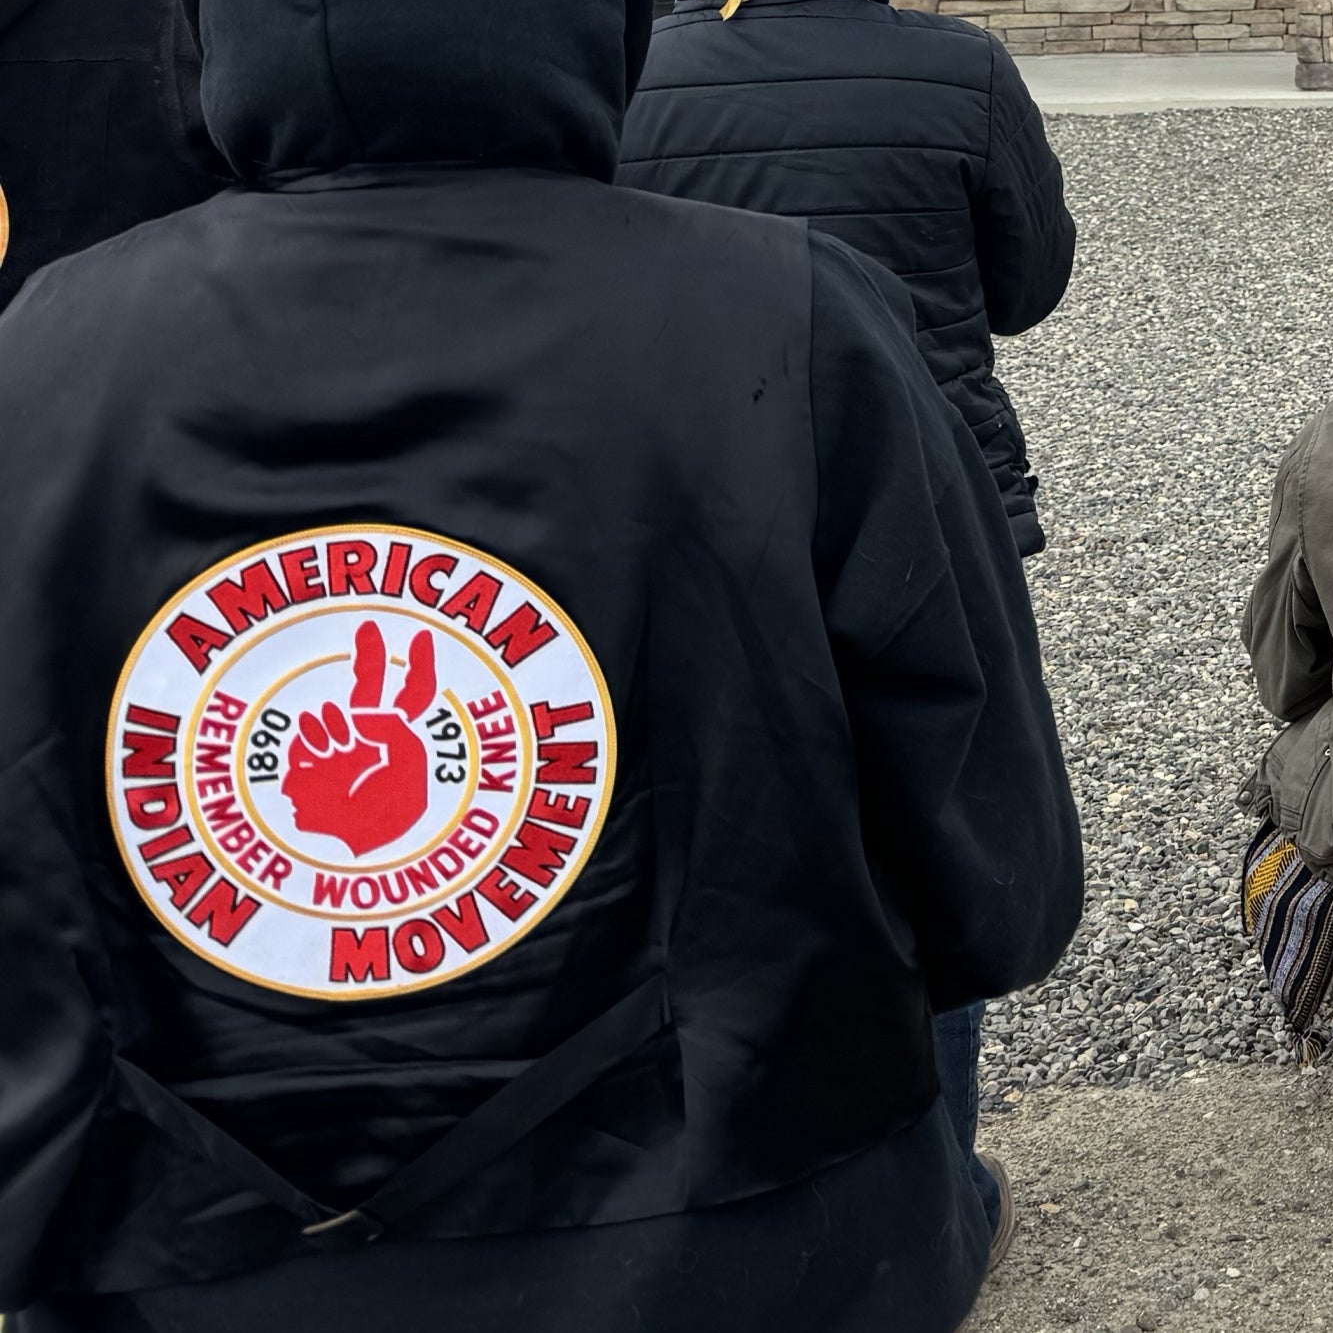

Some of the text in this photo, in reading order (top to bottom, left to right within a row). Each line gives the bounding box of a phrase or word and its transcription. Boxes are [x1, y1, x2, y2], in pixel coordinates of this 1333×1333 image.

[165, 540, 558, 675] AMERICAN
[193, 688, 517, 909] REMEMBER WOUNDED KNEE
[248, 707, 292, 785] 1890
[425, 707, 467, 785] 1973
[122, 700, 598, 983] INDIAN MOVEMENT
